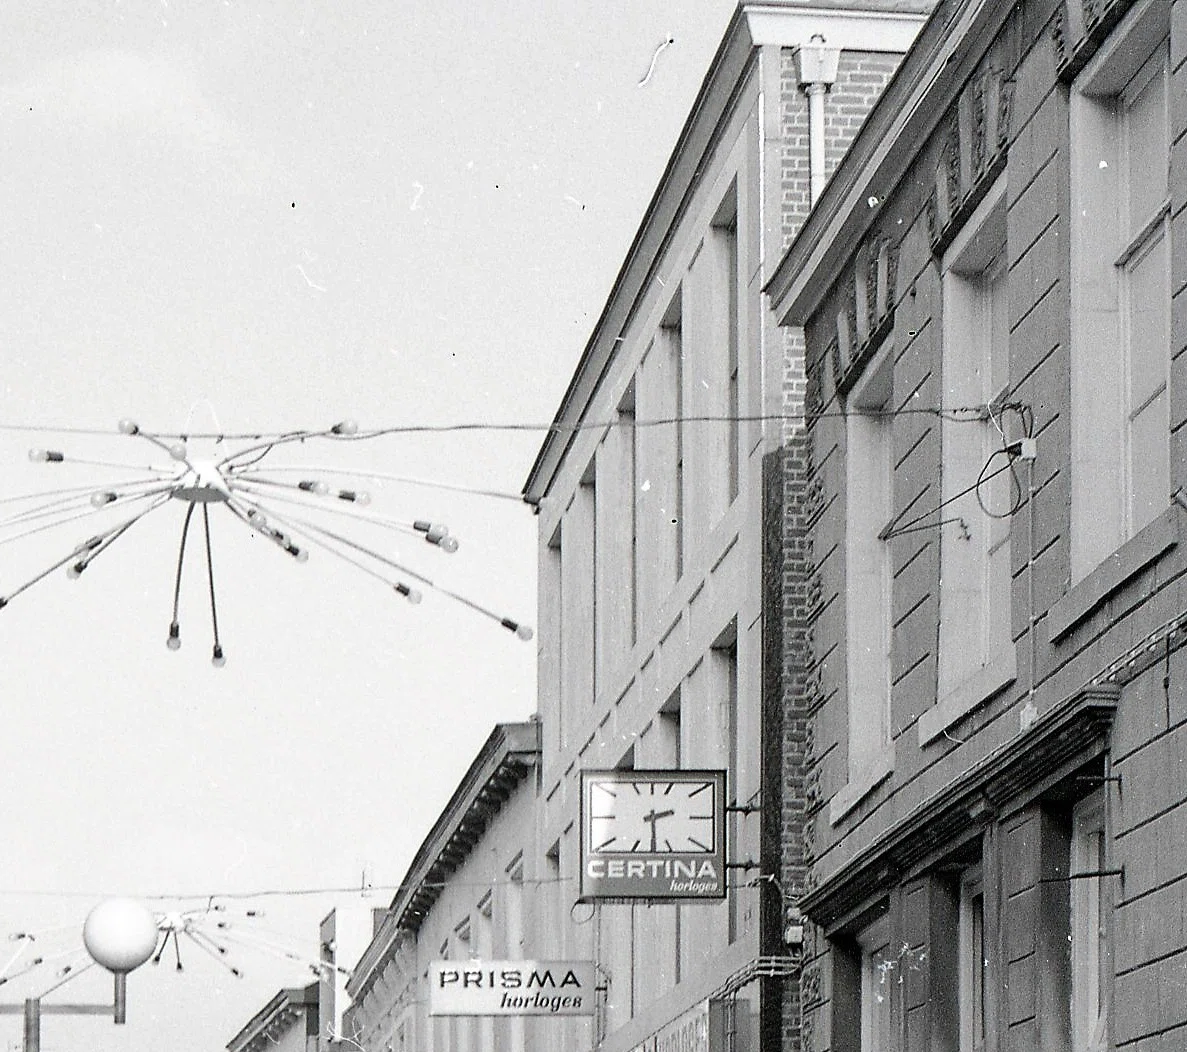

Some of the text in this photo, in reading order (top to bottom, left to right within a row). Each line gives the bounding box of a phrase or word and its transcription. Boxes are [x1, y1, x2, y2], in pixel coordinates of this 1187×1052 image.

[587, 859, 717, 879] CERTINA
[439, 969, 582, 989] PRISMA
[499, 991, 583, 1012] horloges
